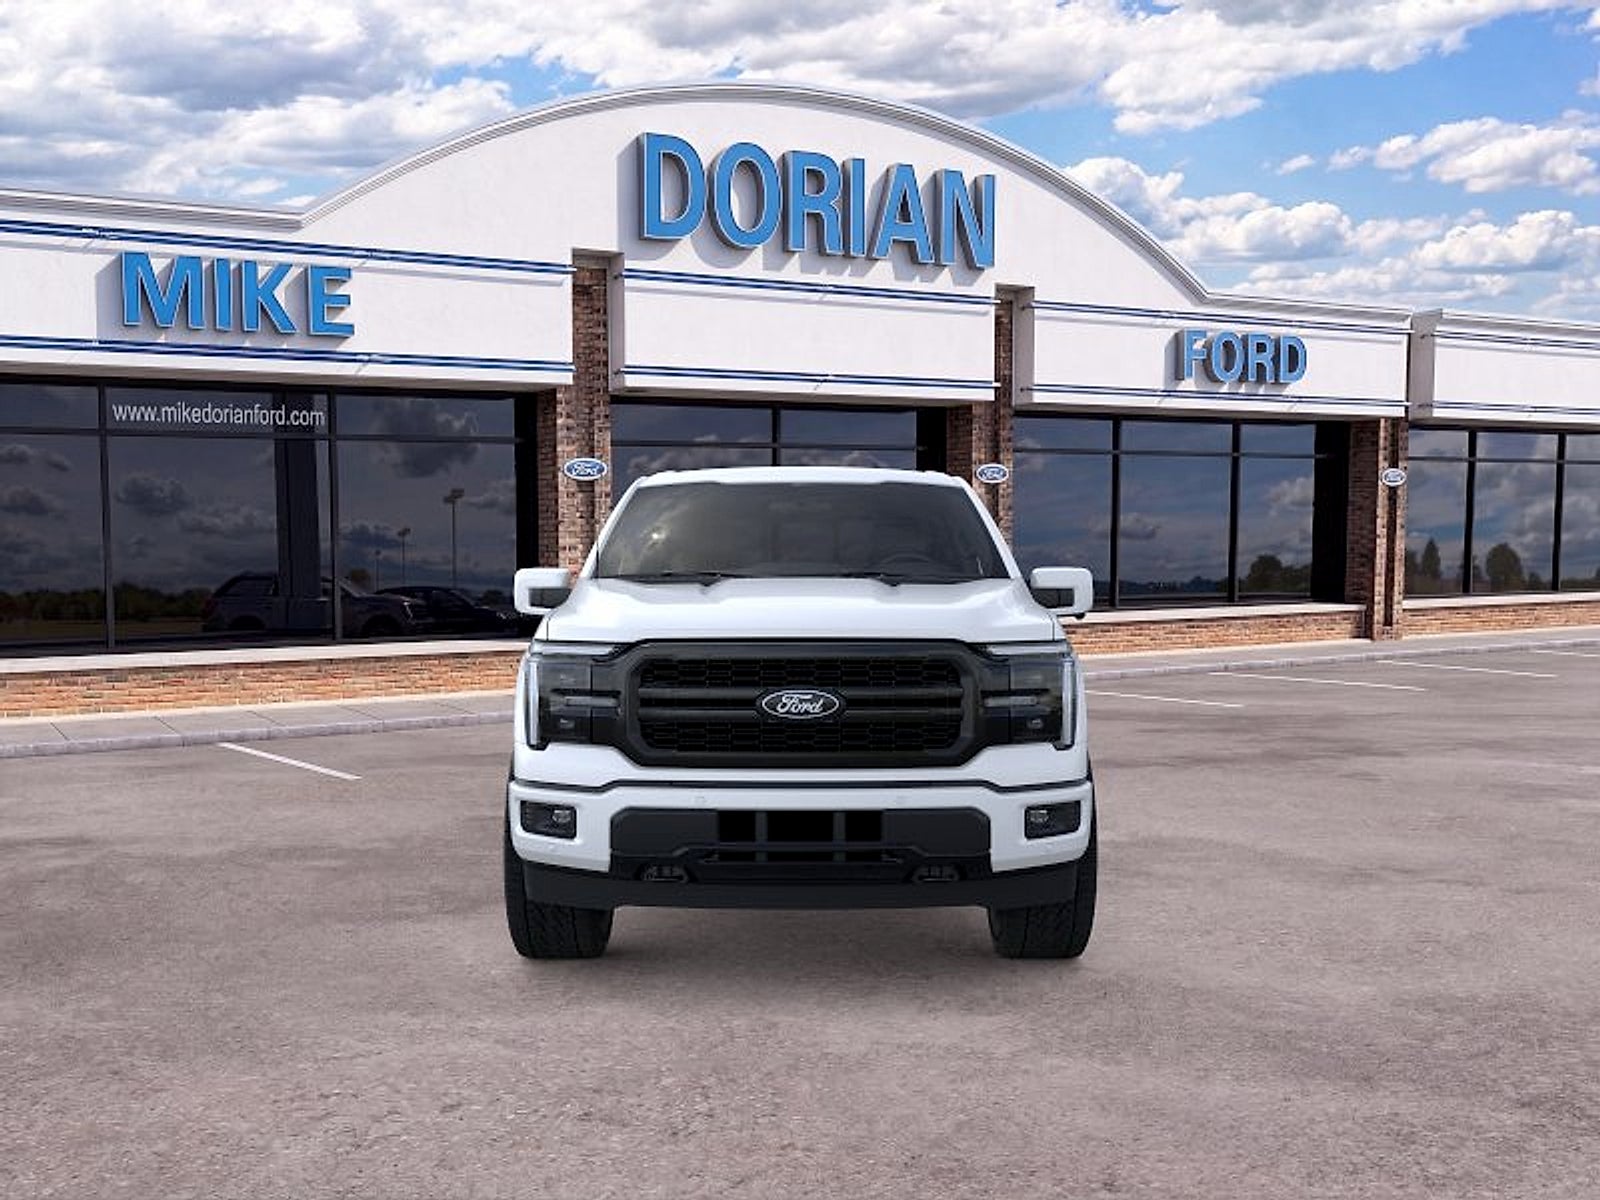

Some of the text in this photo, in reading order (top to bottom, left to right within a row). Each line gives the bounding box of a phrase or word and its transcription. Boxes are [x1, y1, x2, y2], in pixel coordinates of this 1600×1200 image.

[641, 132, 995, 269] DORIAN
[122, 251, 355, 337] MIKE
[1181, 328, 1308, 384] FORD
[112, 402, 326, 426] www.mikedorianford.com
[776, 694, 824, 713] Ford
